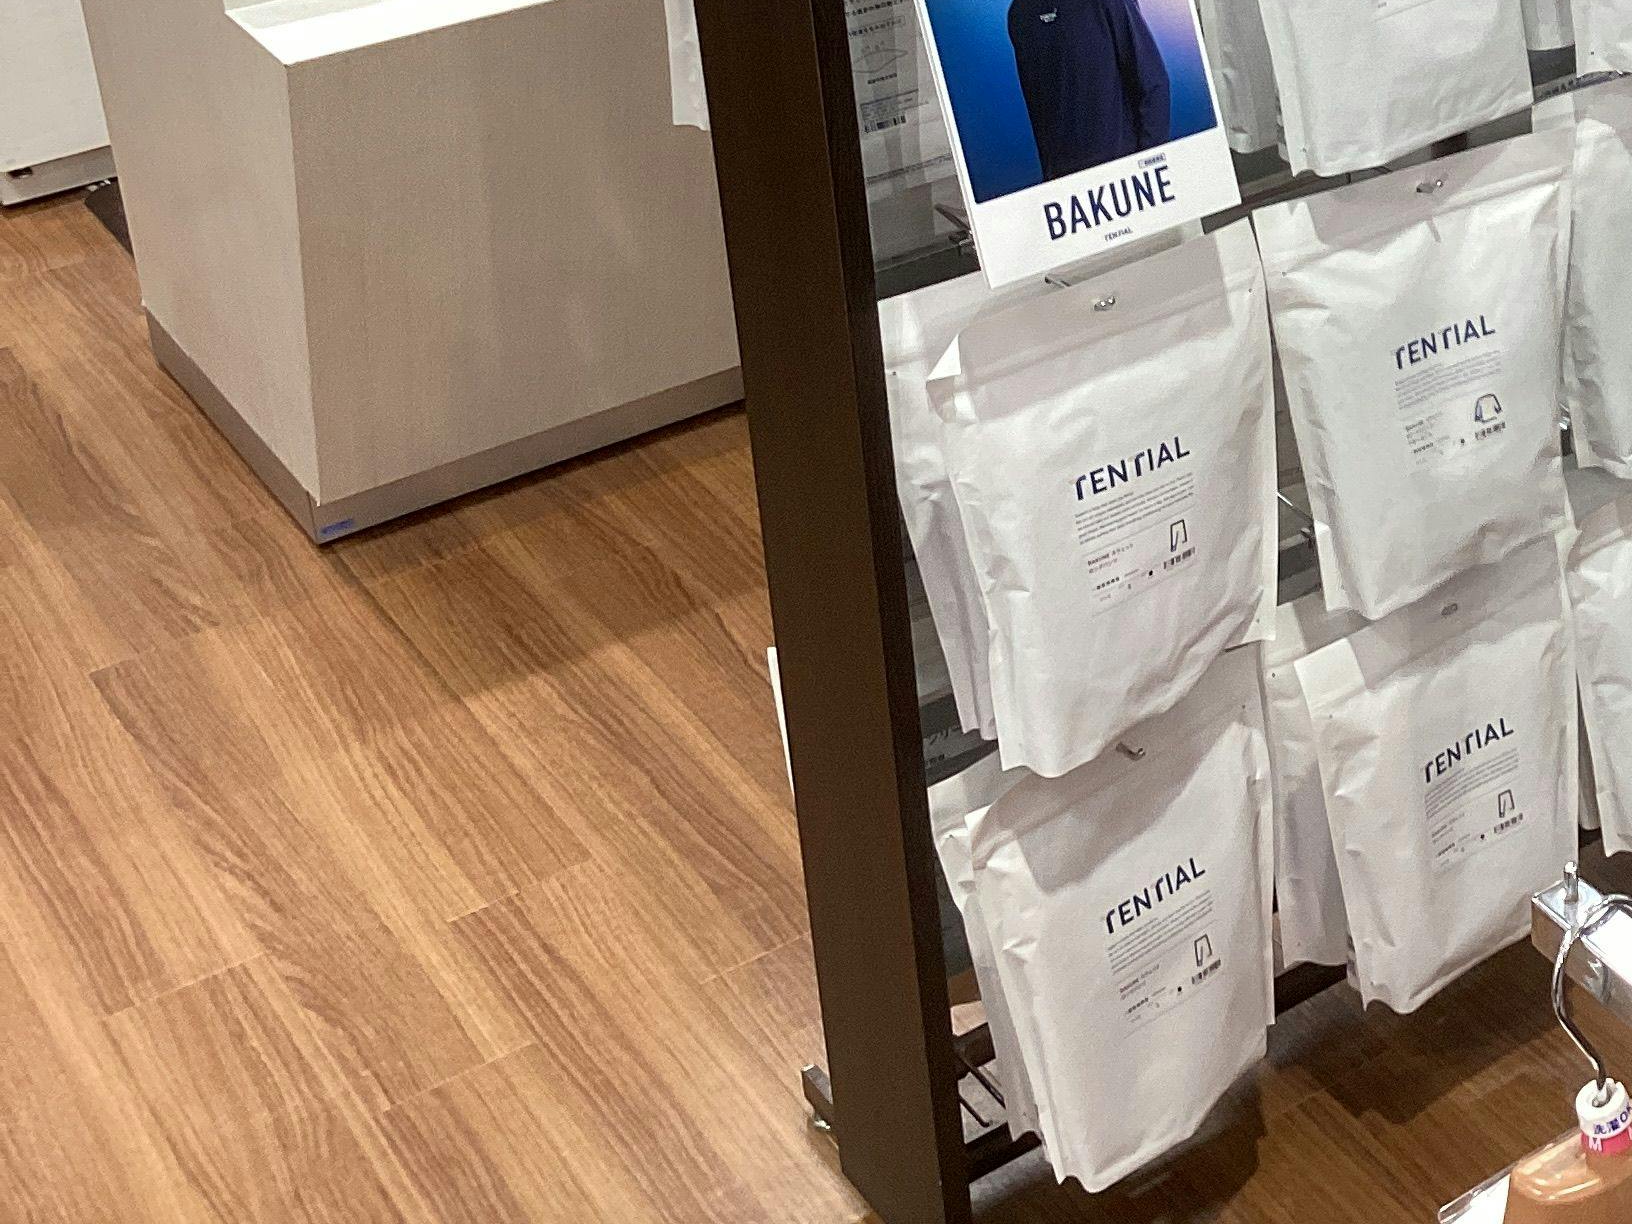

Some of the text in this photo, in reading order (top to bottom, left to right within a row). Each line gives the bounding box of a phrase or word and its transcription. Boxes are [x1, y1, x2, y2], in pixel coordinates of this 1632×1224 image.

[1043, 165, 1176, 241] BAKUNE
[1393, 313, 1497, 371] TENTIAL
[1072, 436, 1191, 502] TENTIAL
[1424, 715, 1515, 784] TENTIAL
[1103, 856, 1207, 936] TENTIAL
